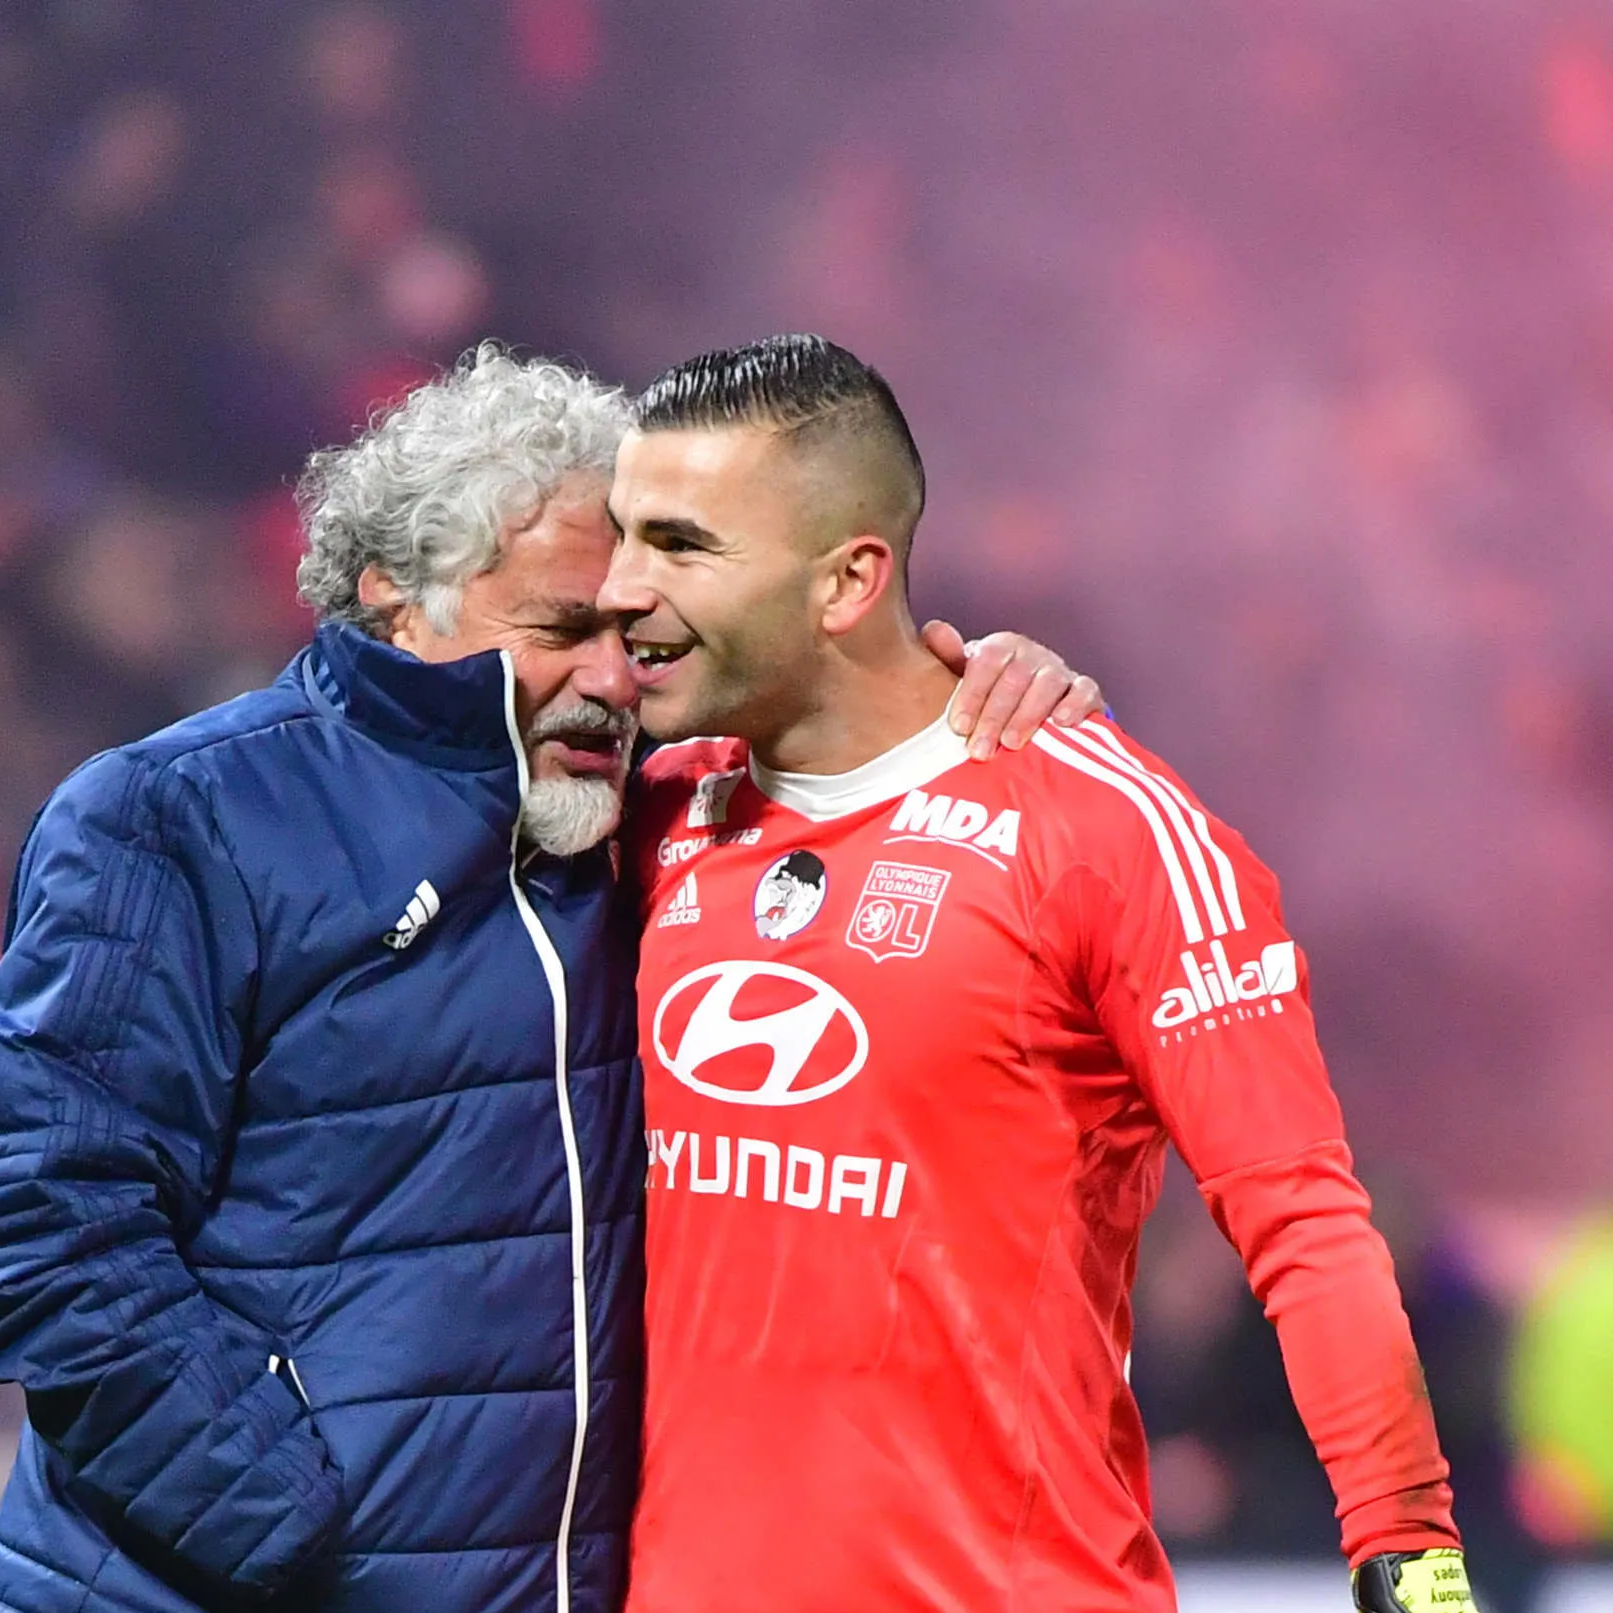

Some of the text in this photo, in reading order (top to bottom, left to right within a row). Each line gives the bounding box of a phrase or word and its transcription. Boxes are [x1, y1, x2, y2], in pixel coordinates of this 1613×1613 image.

[889, 788, 1021, 857] MDA
[657, 827, 763, 867] Grouma
[874, 866, 944, 888] OLYMPIQUE
[870, 879, 938, 900] LYONNAIS
[657, 907, 701, 928] adidas
